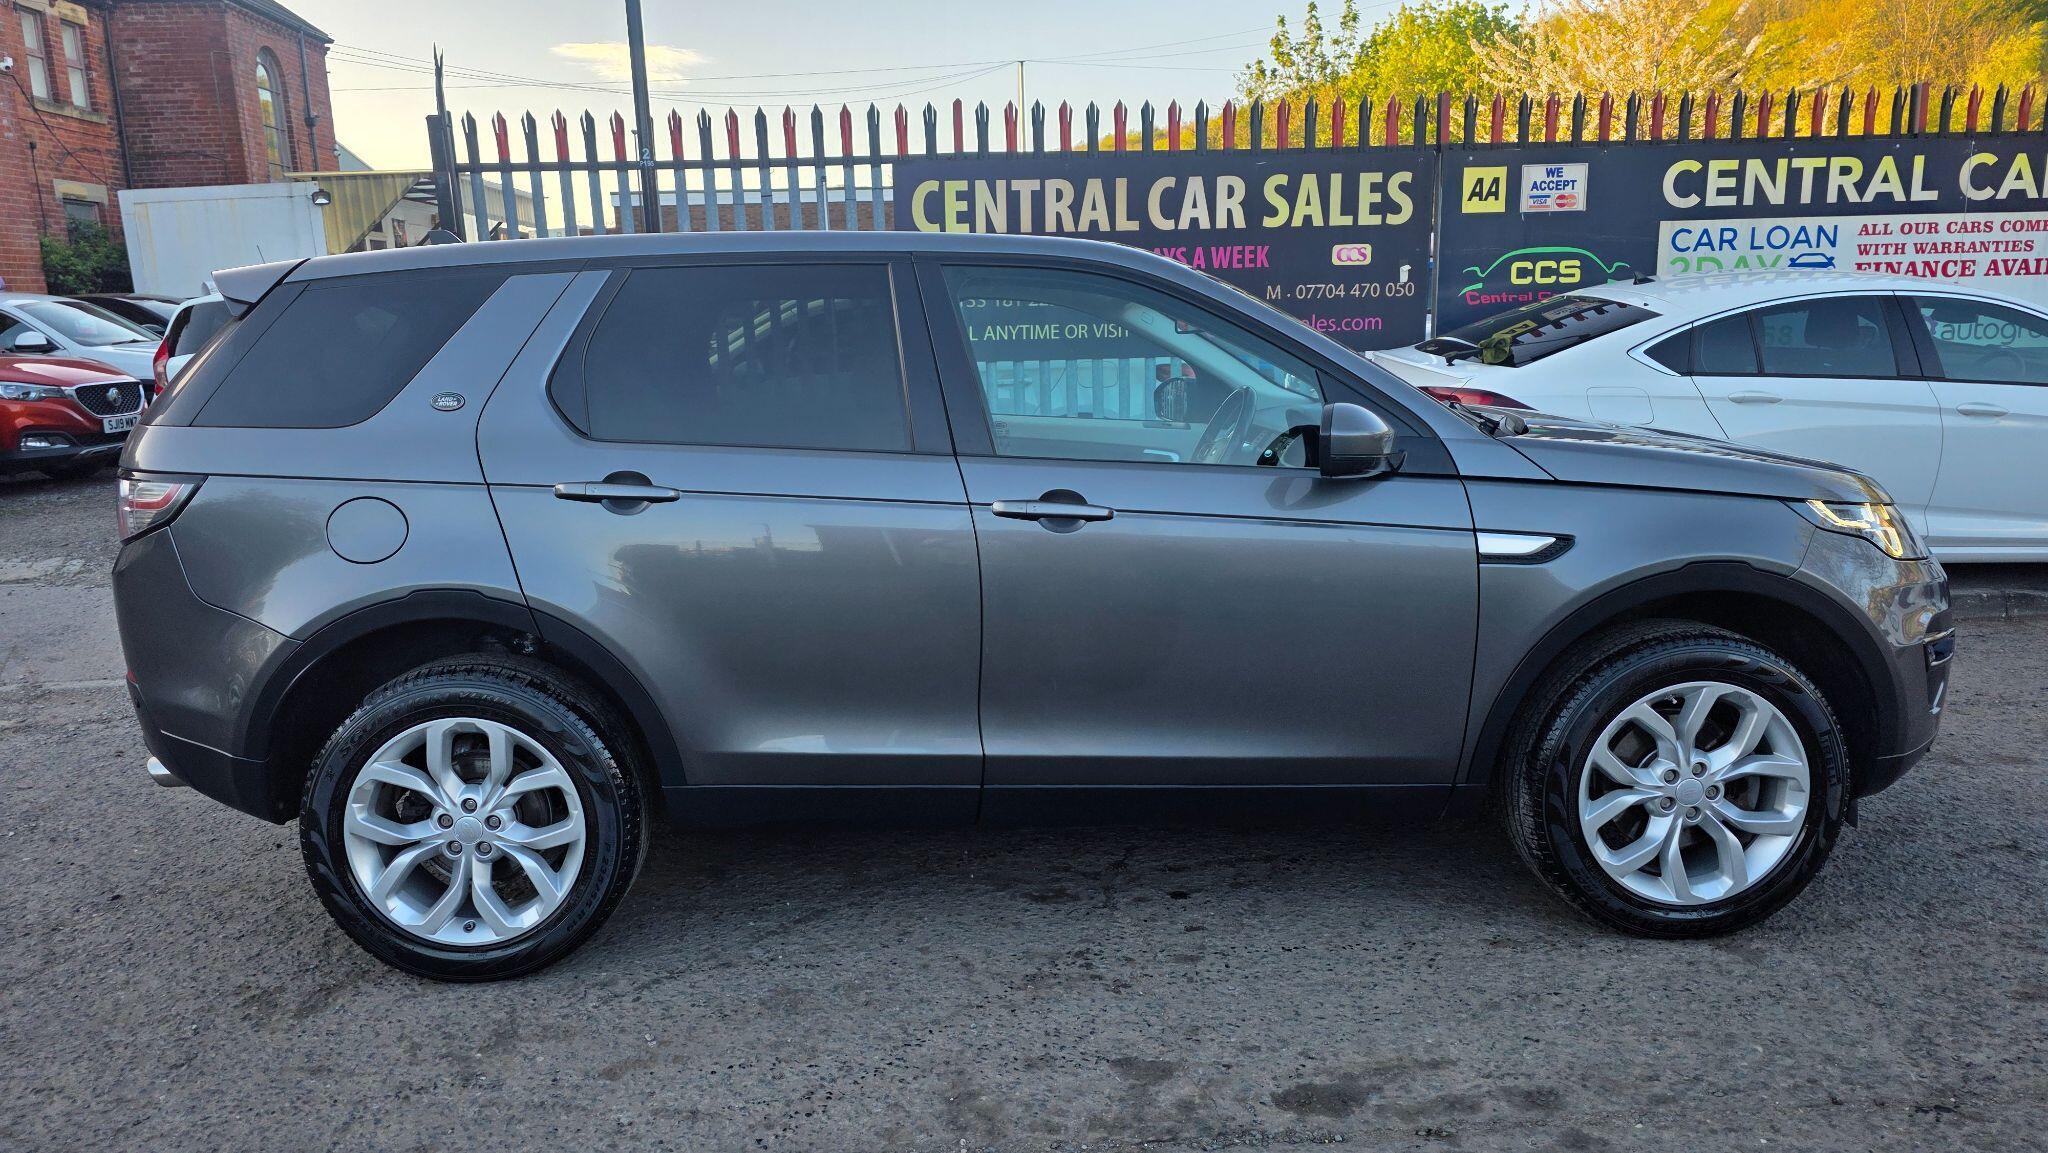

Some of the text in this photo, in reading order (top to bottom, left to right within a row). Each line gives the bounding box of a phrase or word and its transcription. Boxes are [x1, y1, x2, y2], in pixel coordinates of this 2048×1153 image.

[1545, 166, 1564, 179] WE
[1662, 152, 2048, 208] CENTRAL CA
[1467, 176, 1500, 202] AA
[1530, 179, 1578, 192] ACCEPT
[911, 171, 1414, 234] CENTRAL CAR SALES
[1531, 197, 1548, 205] VISA
[1857, 223, 1894, 236] ALL
[1900, 221, 1940, 235] OUR
[1946, 220, 1994, 234] CARS
[1670, 224, 1838, 253] CAR LOAN
[1857, 239, 2035, 256] WITH WARRANTIES
[1192, 246, 1206, 269] A
[1210, 245, 1270, 269] WEEK
[1510, 259, 1582, 285] CCS
[1854, 257, 2048, 278] FINANCE AVAI
[1296, 284, 1345, 299] 07704
[1350, 283, 1380, 298] 470
[1385, 282, 1415, 297] 050
[1465, 290, 1533, 305] Central
[984, 325, 1060, 341] ANYTIME
[1064, 324, 1088, 340] OR
